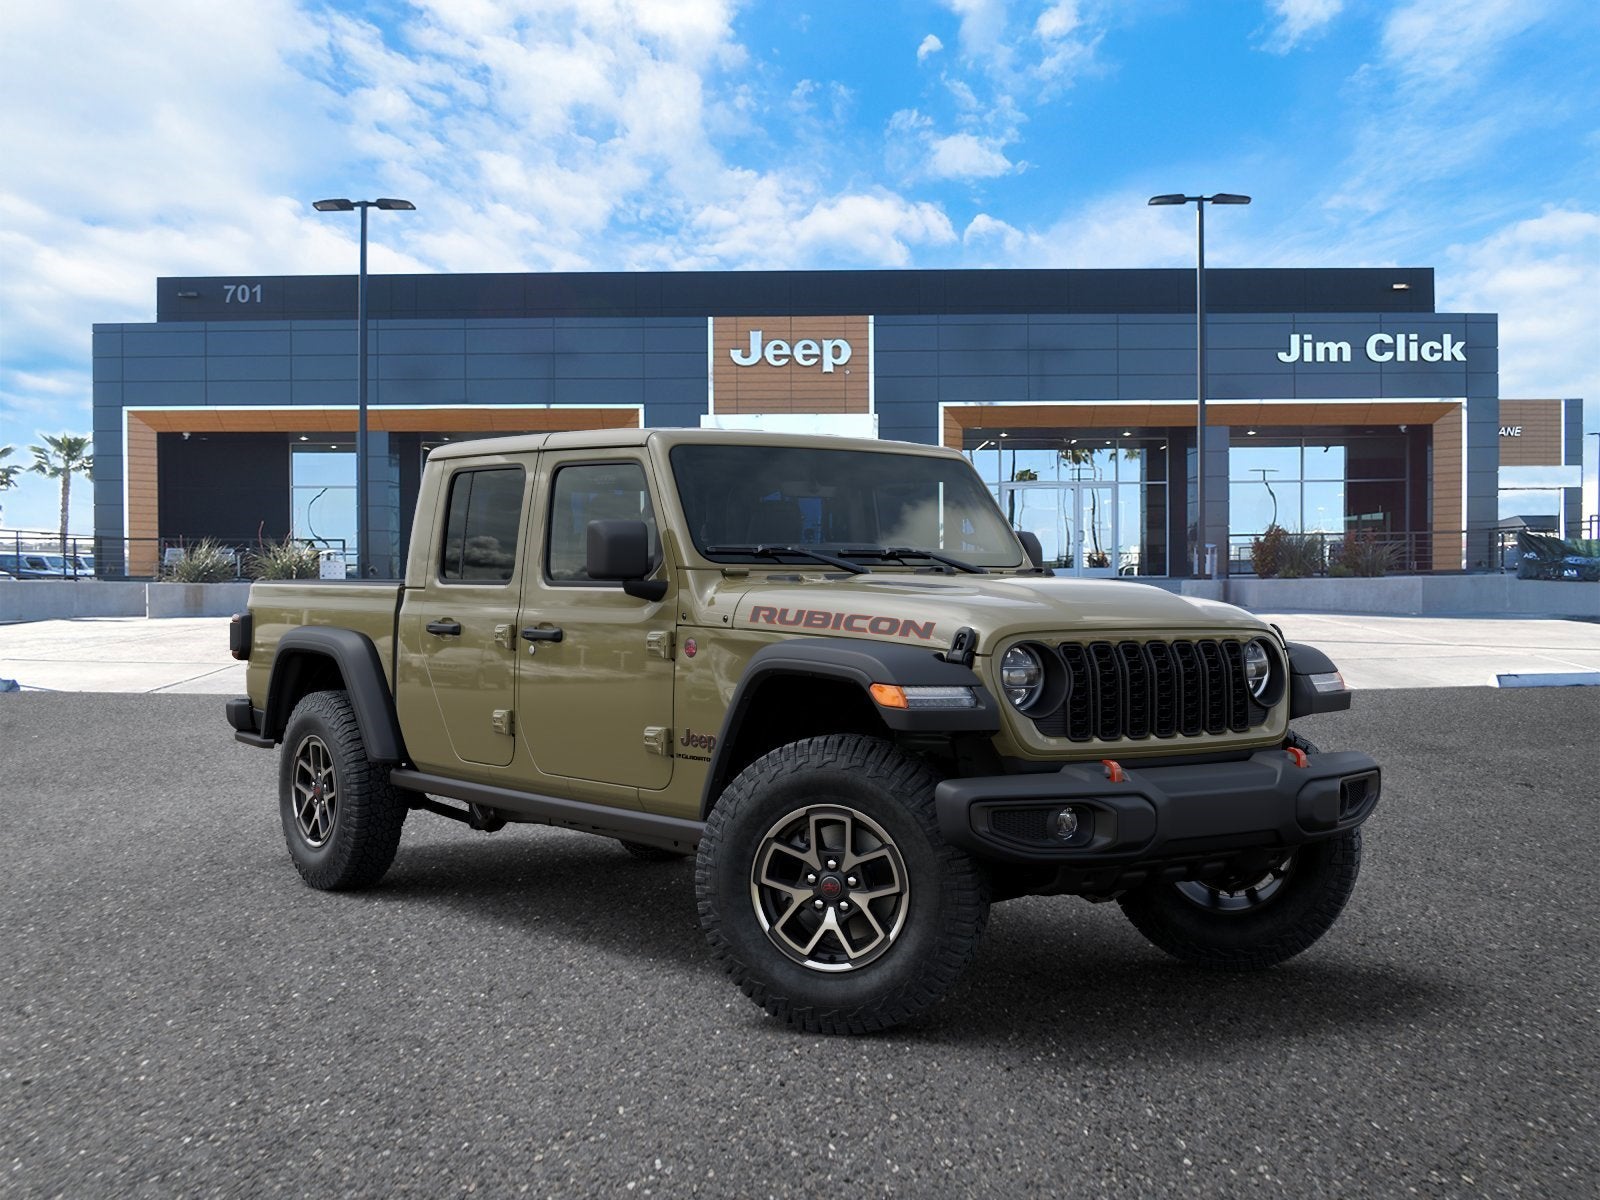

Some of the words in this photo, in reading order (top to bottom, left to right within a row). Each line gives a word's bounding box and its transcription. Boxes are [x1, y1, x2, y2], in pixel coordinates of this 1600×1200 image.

[223, 284, 261, 303] 701
[730, 330, 852, 373] Jeep
[1277, 334, 1351, 362] Jim
[1366, 333, 1467, 362] Click
[750, 605, 936, 640] RUBICON
[680, 728, 717, 753] Jeep
